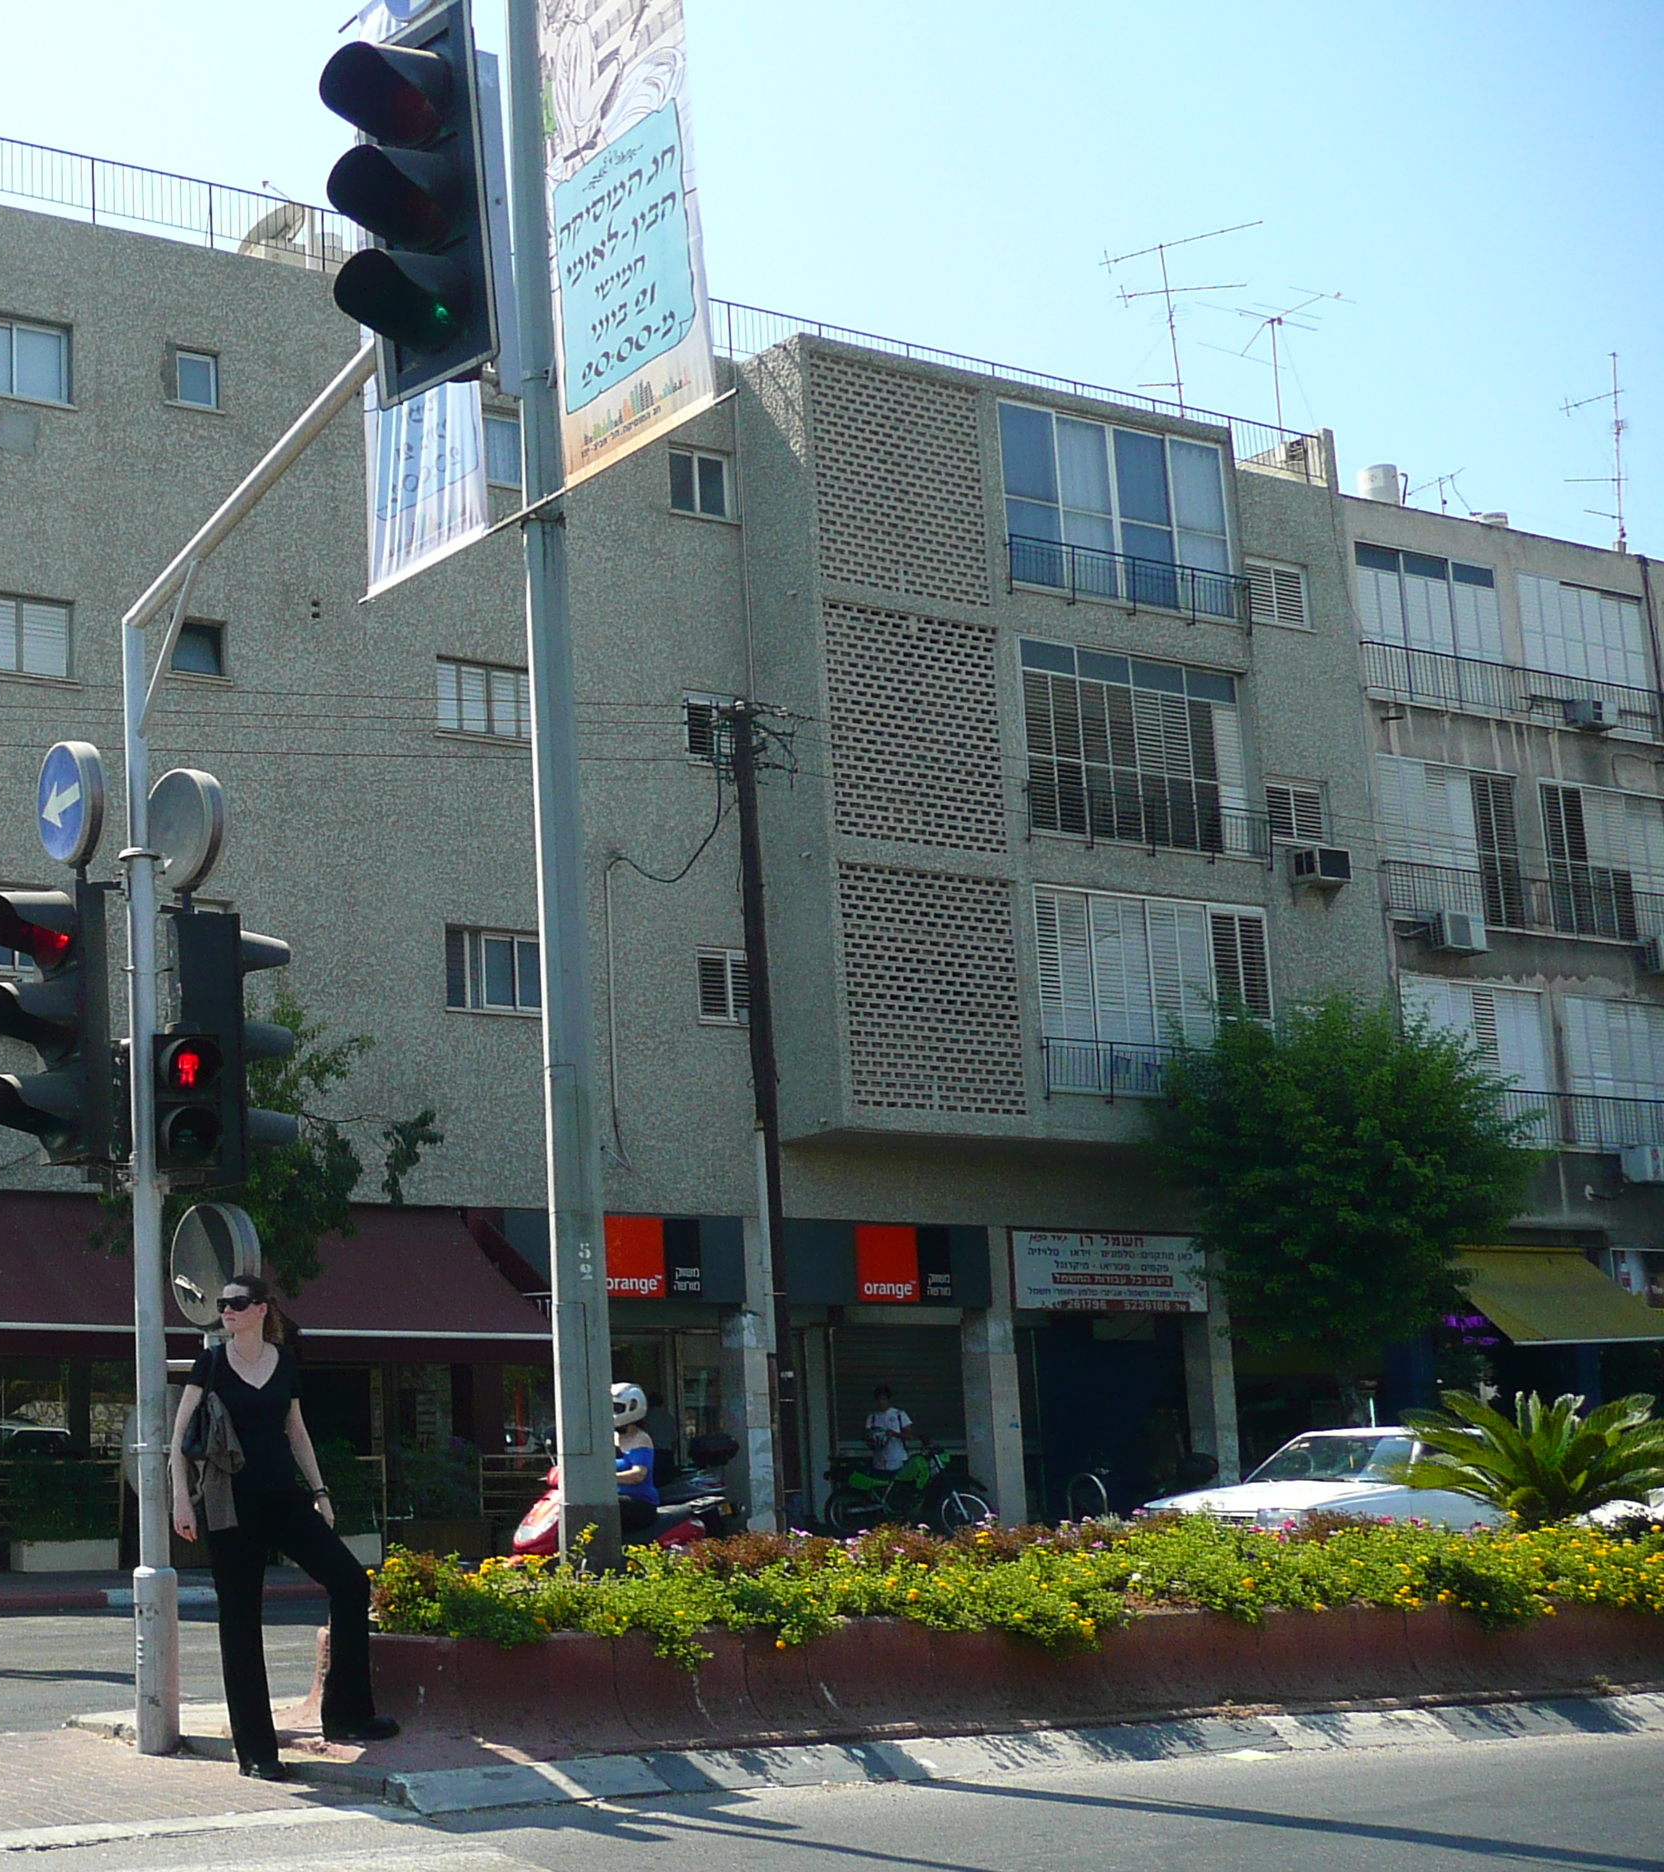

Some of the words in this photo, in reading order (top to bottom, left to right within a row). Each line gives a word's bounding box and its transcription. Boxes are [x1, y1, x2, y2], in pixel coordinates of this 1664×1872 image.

[646, 144, 676, 186] חג
[558, 168, 643, 250] המוסיקה
[594, 254, 646, 302] חמישי
[635, 281, 657, 316] 21
[590, 302, 628, 343] ביוני
[1079, 1234, 1094, 1247] רן
[1100, 1234, 1144, 1247] חשמל
[606, 1277, 658, 1294] orange
[864, 1282, 913, 1299] orange
